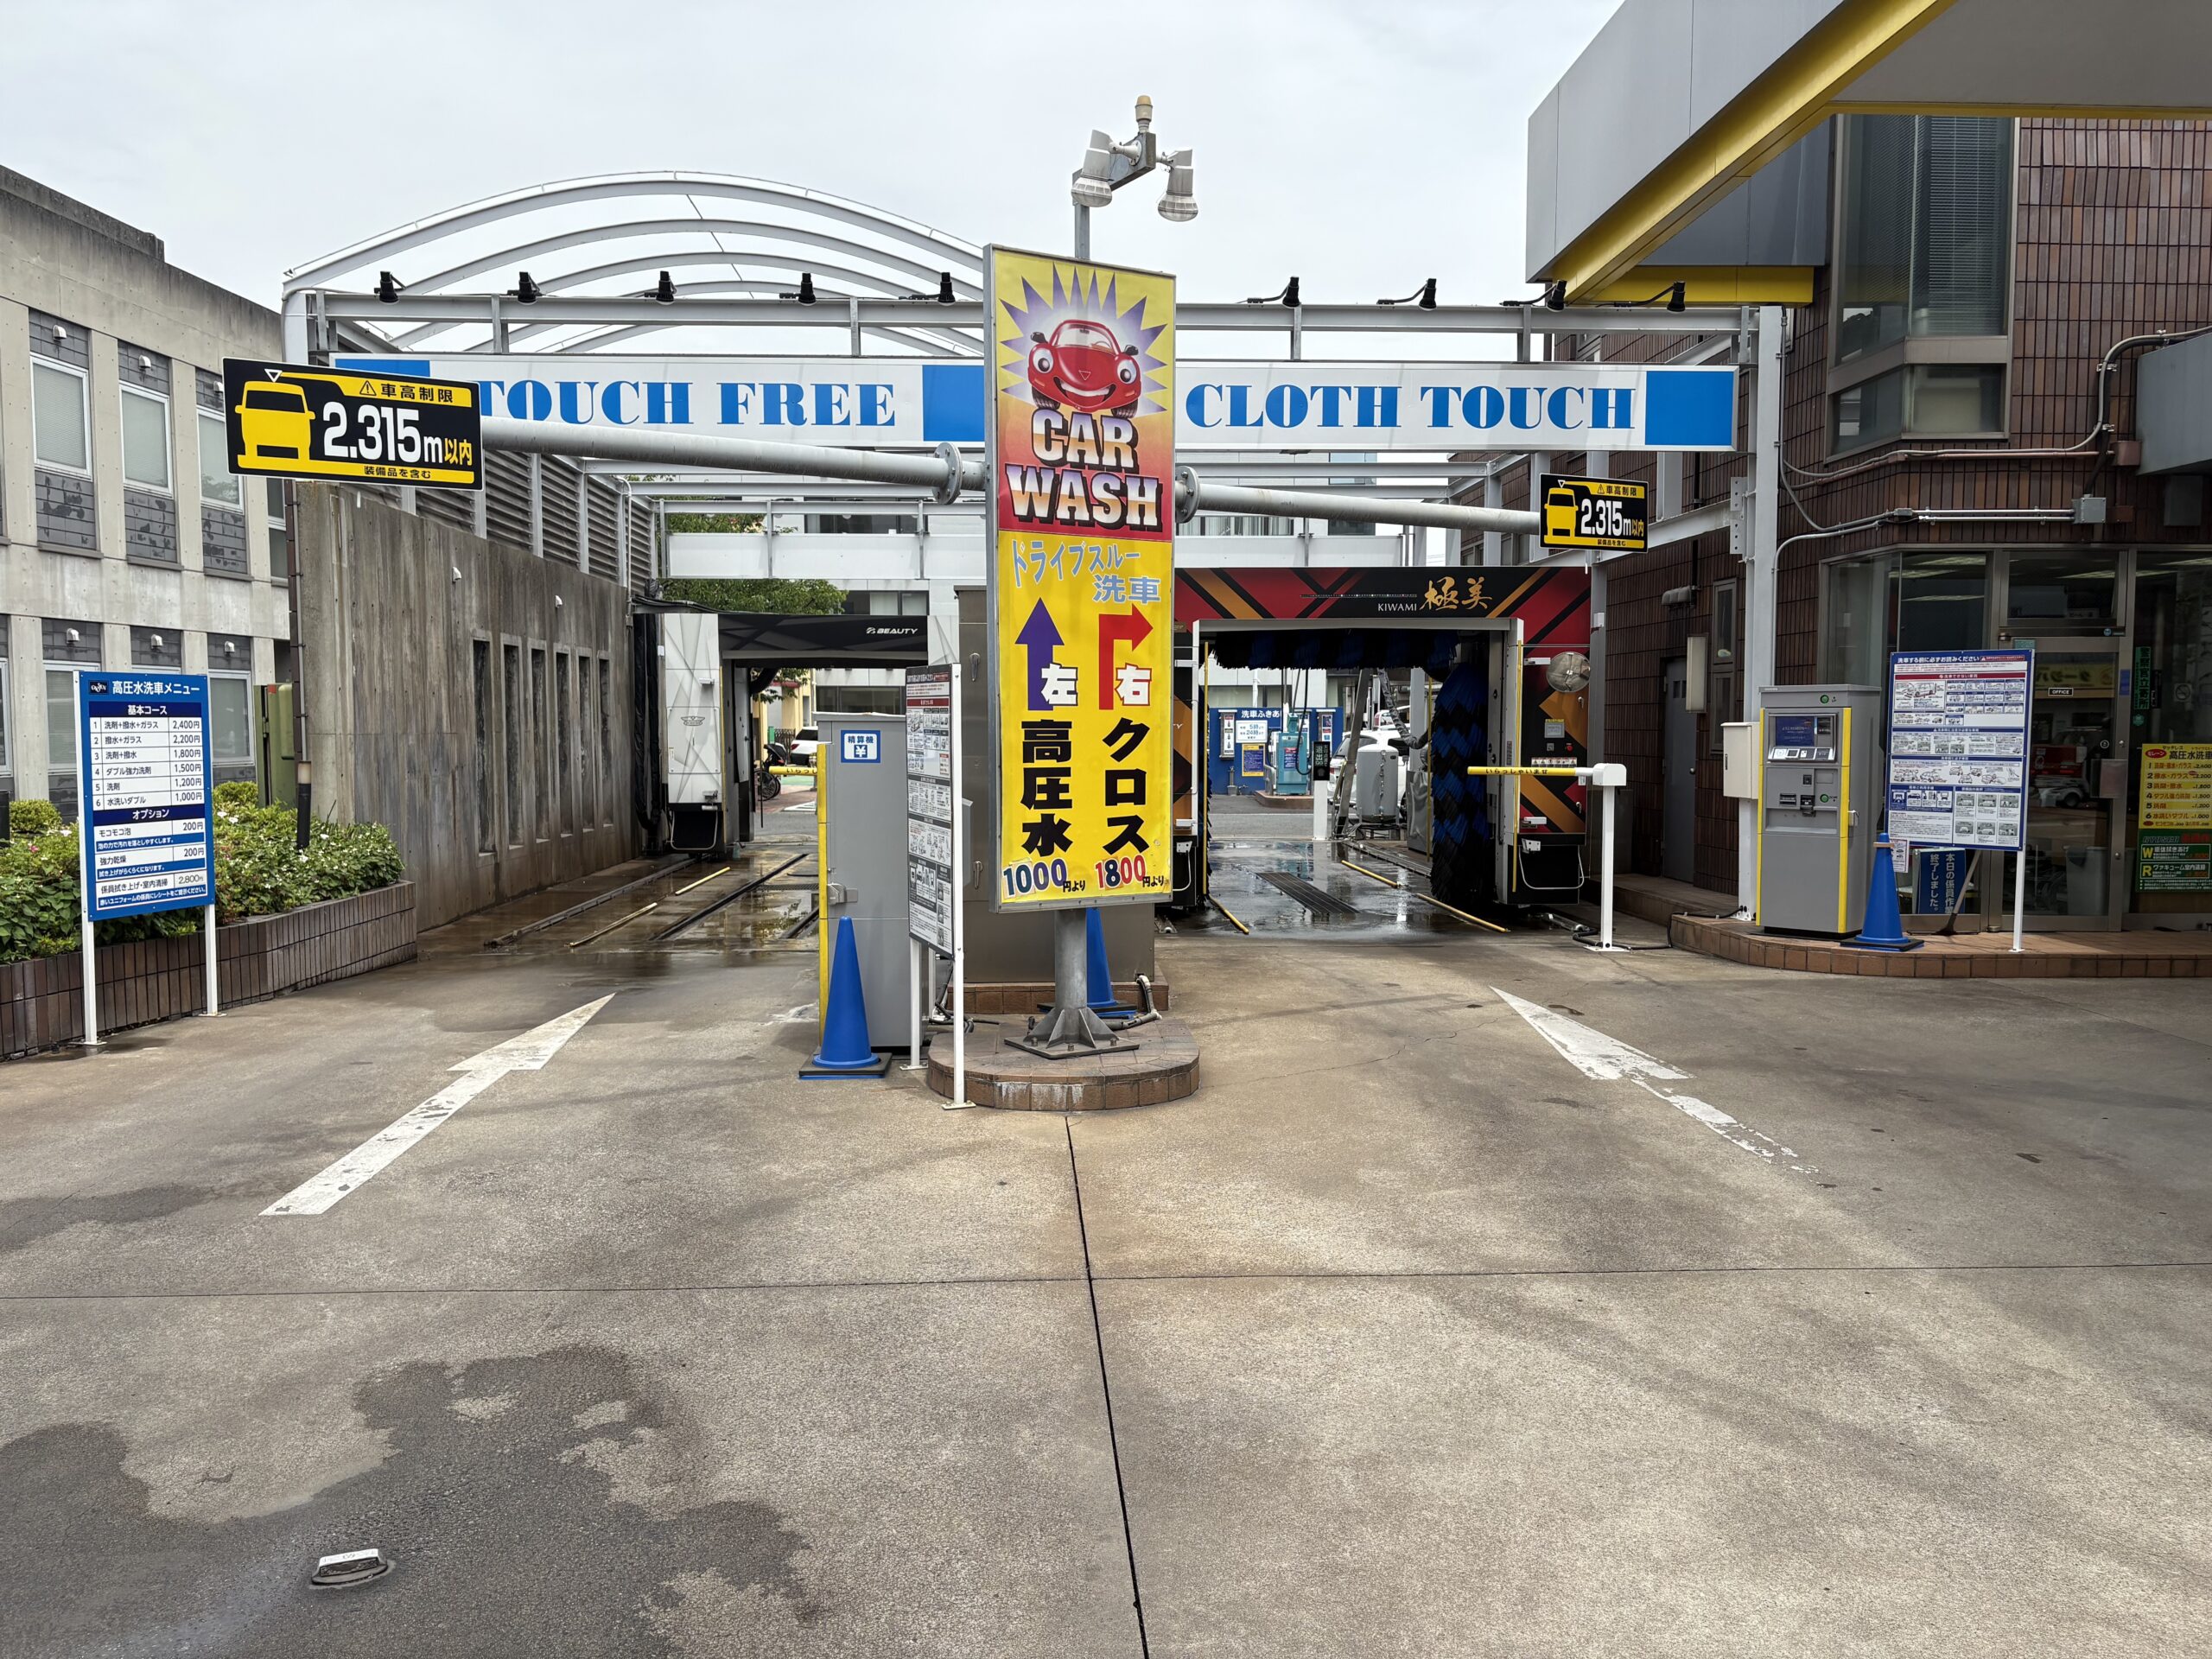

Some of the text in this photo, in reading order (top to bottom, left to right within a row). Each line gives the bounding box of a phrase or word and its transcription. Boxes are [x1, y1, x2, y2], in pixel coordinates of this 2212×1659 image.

[380, 383, 454, 404] 車高制限
[716, 382, 896, 427] FREE
[1185, 384, 1635, 429] CLOTH TOUCH
[1032, 408, 1139, 472] CAR
[363, 466, 431, 479] 装備品を含む
[1005, 464, 1162, 530] WASH
[1606, 485, 1637, 497] 車高制限
[1012, 539, 1141, 588] ドライブスルー
[1092, 574, 1161, 604] 洗車
[1377, 576, 1493, 612] KIWAMI 極美
[112, 681, 200, 695] 高圧水洗車メニュー
[1041, 663, 1078, 706] 左
[1115, 663, 1152, 707] 右
[127, 705, 168, 715] 基本コース
[1241, 709, 1282, 719] 洗車ふきあ
[173, 720, 200, 729] 2,400円
[173, 734, 200, 744] 2,200円
[848, 735, 874, 744] 精算機
[174, 749, 201, 759] 1,800円
[106, 766, 152, 776] ダブル強力洗剤
[174, 763, 201, 773] 1,500円
[175, 778, 201, 787] 1,200円
[1020, 718, 1073, 857] 高圧水
[1103, 717, 1151, 855] クロス
[107, 796, 146, 806] 水洗いダブル
[175, 791, 202, 802] 1,000円
[132, 809, 170, 820] オプション
[99, 821, 204, 837] モコモコ泡 200円
[99, 848, 205, 865] 強力乾燥 200円
[2143, 847, 2153, 858] W
[2142, 865, 2152, 877] R
